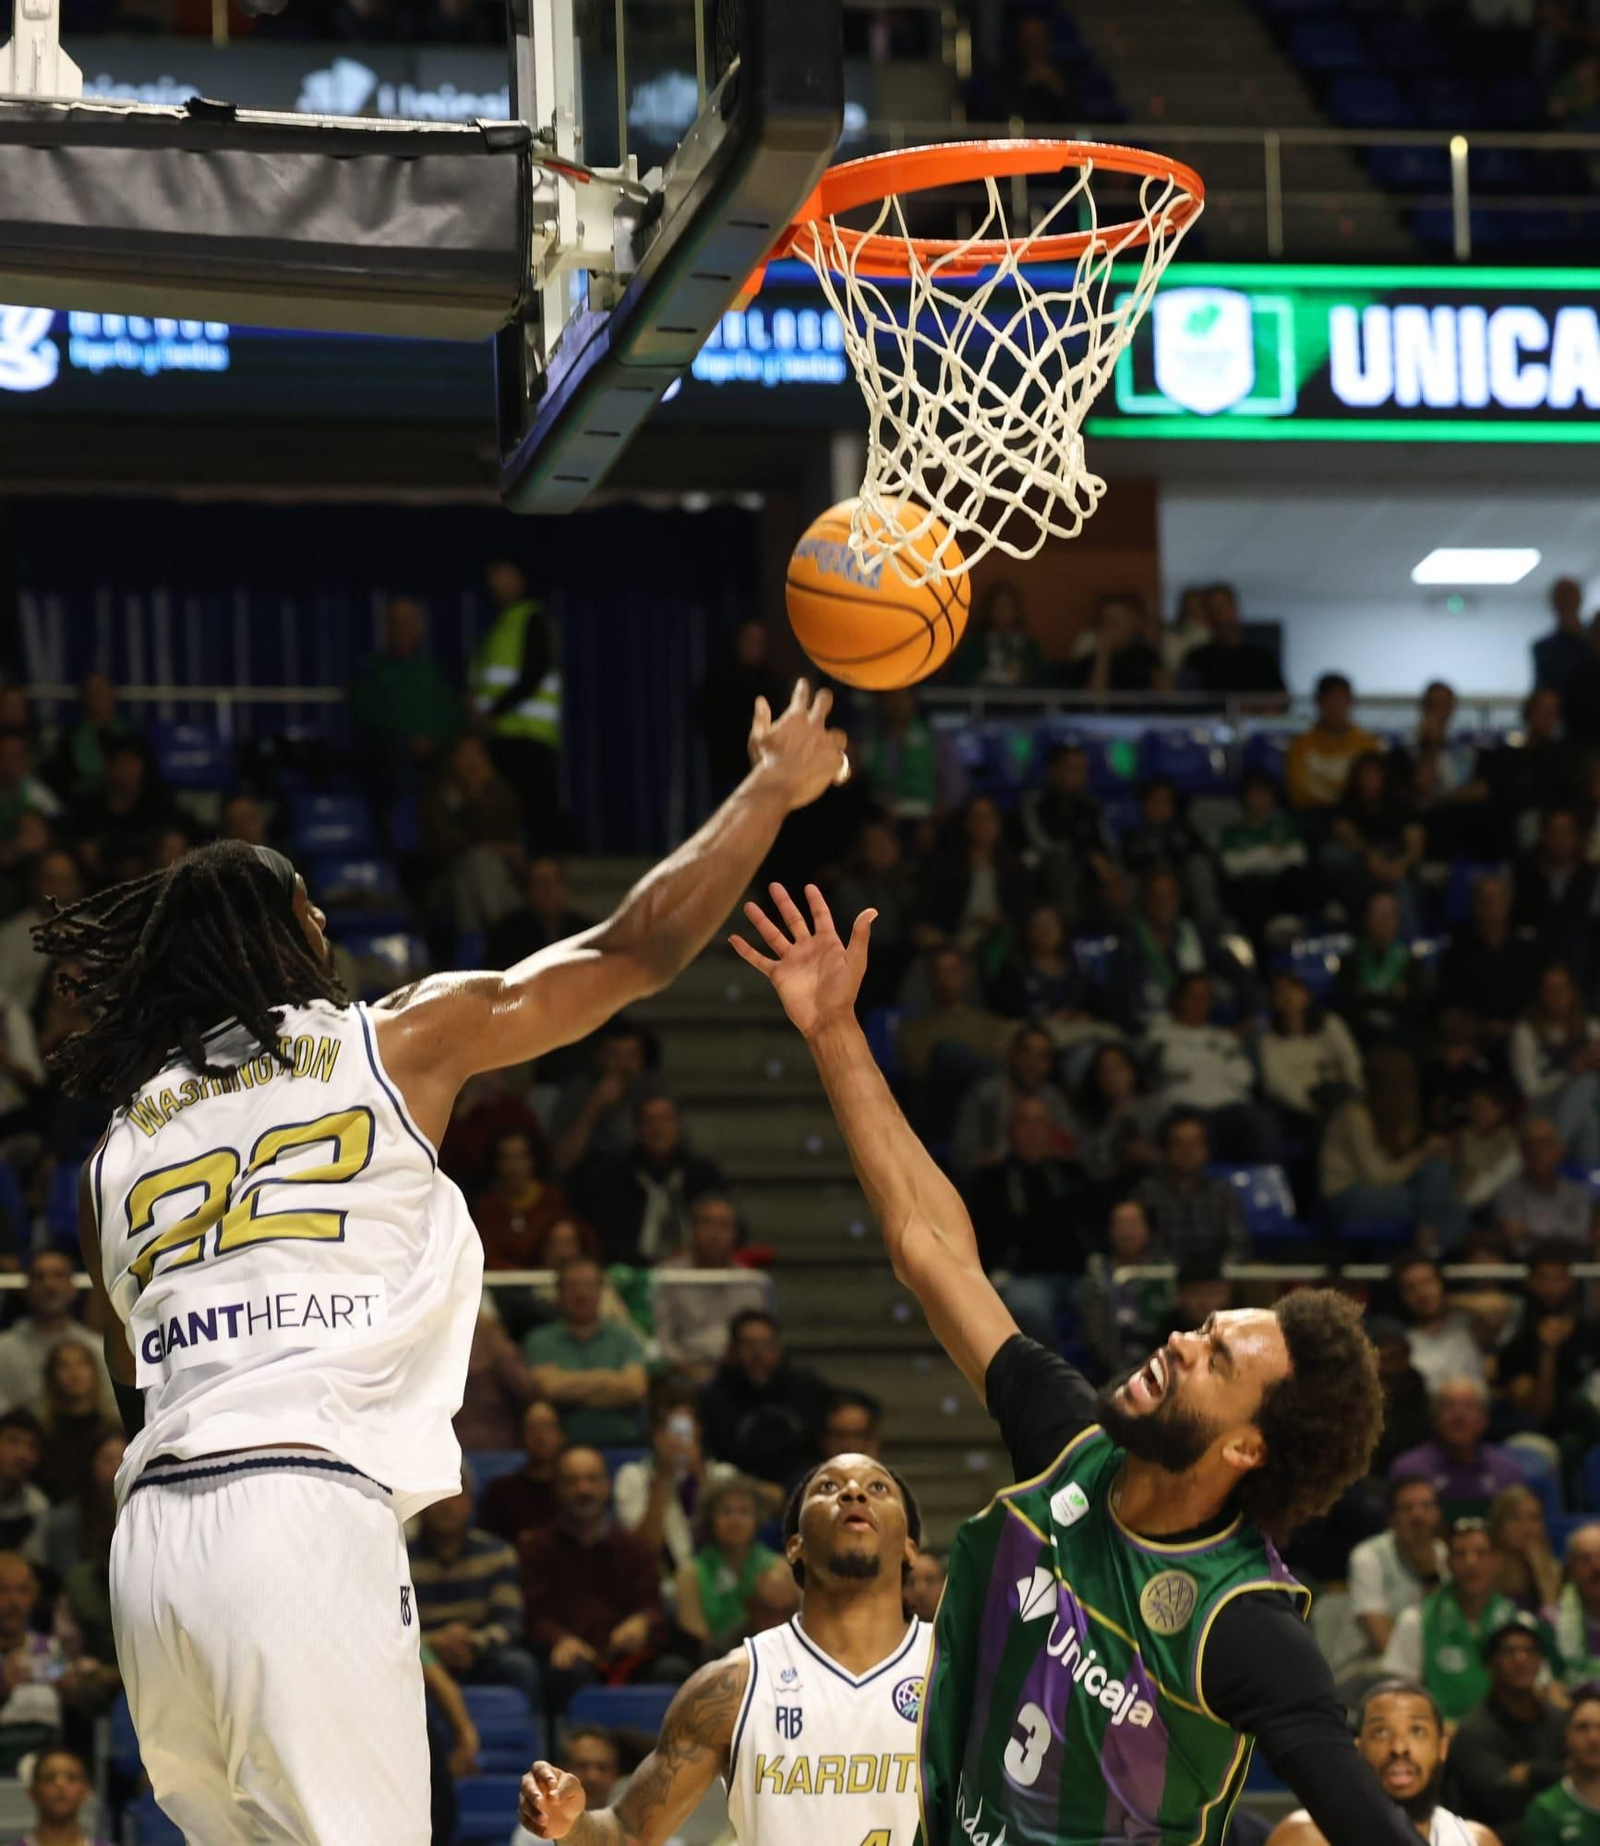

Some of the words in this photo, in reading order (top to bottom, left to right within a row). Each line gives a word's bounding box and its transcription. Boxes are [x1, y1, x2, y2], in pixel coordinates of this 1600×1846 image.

[1329, 304, 1600, 409] UNICA
[124, 1105, 376, 1294] 22
[1046, 1614, 1154, 1729] Unicaja
[754, 1753, 918, 1795] KARDIT
[1003, 1702, 1052, 1786] 3
